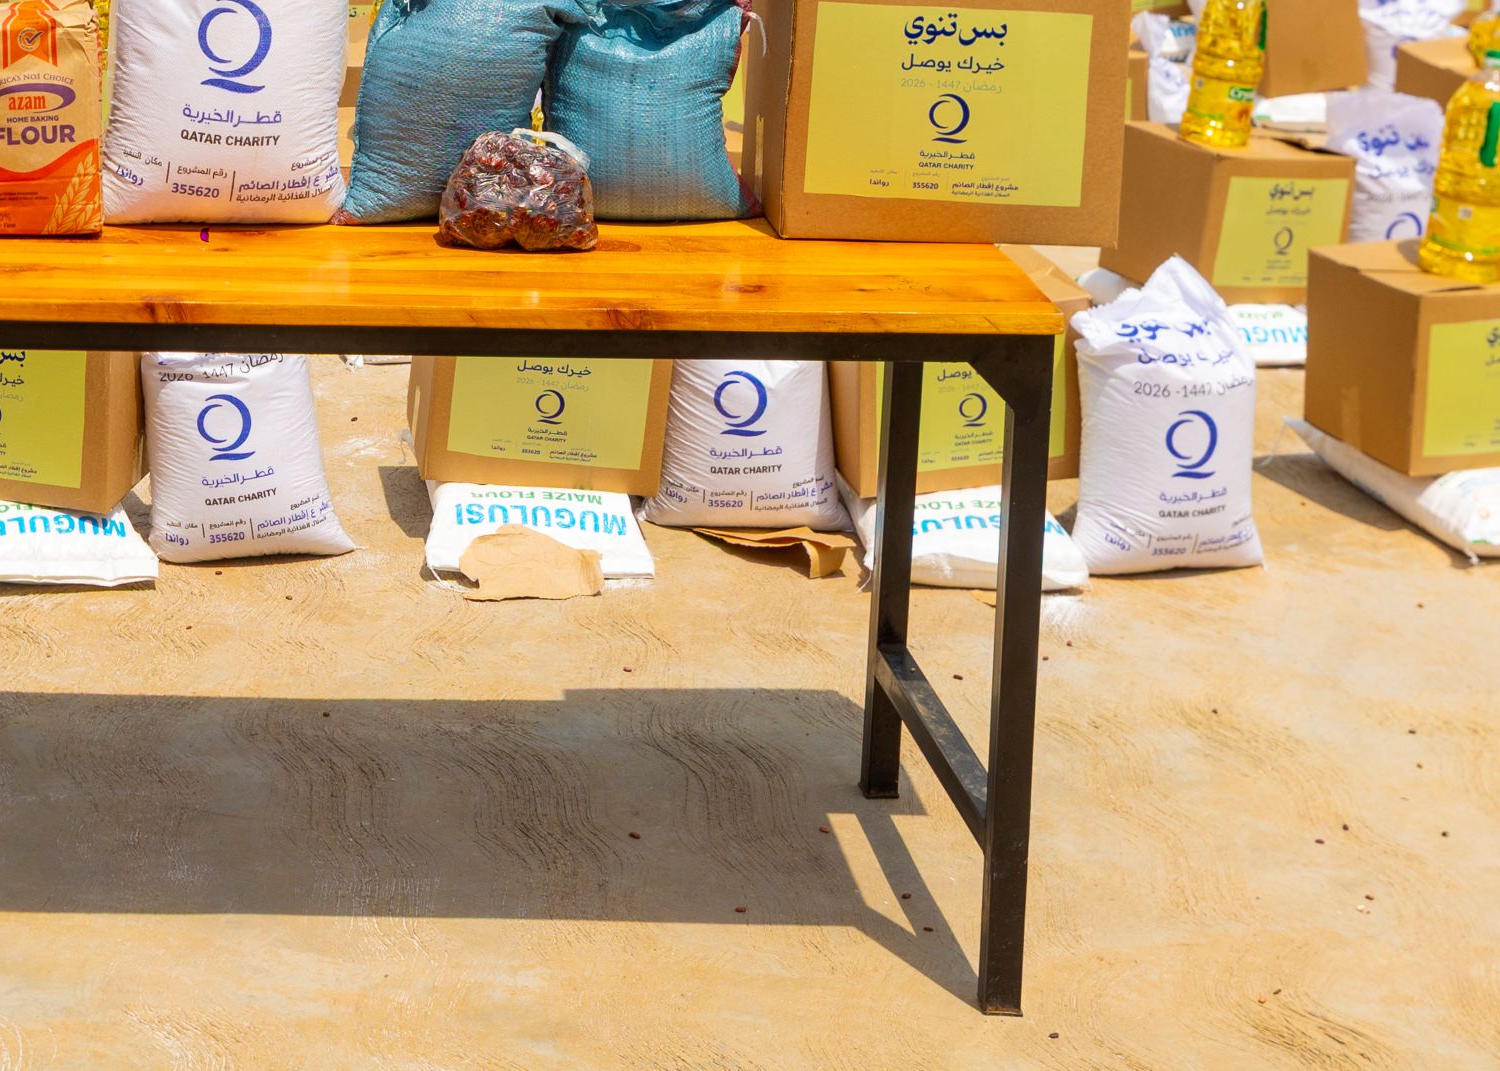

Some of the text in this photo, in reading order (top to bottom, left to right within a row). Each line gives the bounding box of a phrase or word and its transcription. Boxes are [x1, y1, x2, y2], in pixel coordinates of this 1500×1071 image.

[904, 13, 1008, 47] بس تنوي
[901, 53, 1005, 75] خيرك يوصل
[43, 73, 74, 85] CHOICE
[900, 78, 926, 89] 2026
[963, 80, 1002, 94] رمضان
[8, 96, 46, 111] azam
[182, 104, 282, 128] قطر الخيرية
[180, 129, 281, 147] QATAR CHARITY
[944, 162, 974, 170] CHARITY
[171, 183, 220, 199] 355620
[239, 180, 279, 193] الصائم
[517, 360, 592, 377] خيرك يوصل
[937, 369, 972, 381] يوصل
[1134, 381, 1171, 398] 2026
[709, 447, 748, 459] الخيرية
[710, 464, 782, 475] QATAR CHARITY
[202, 475, 240, 488] الخيرية
[205, 488, 277, 507] QATAR CHARITY
[541, 491, 603, 504] MAIZE
[708, 500, 743, 508] 355620
[1159, 504, 1226, 519] QATAR CHARITY
[455, 503, 627, 536] MUGULUSI
[210, 531, 245, 544] 355620
